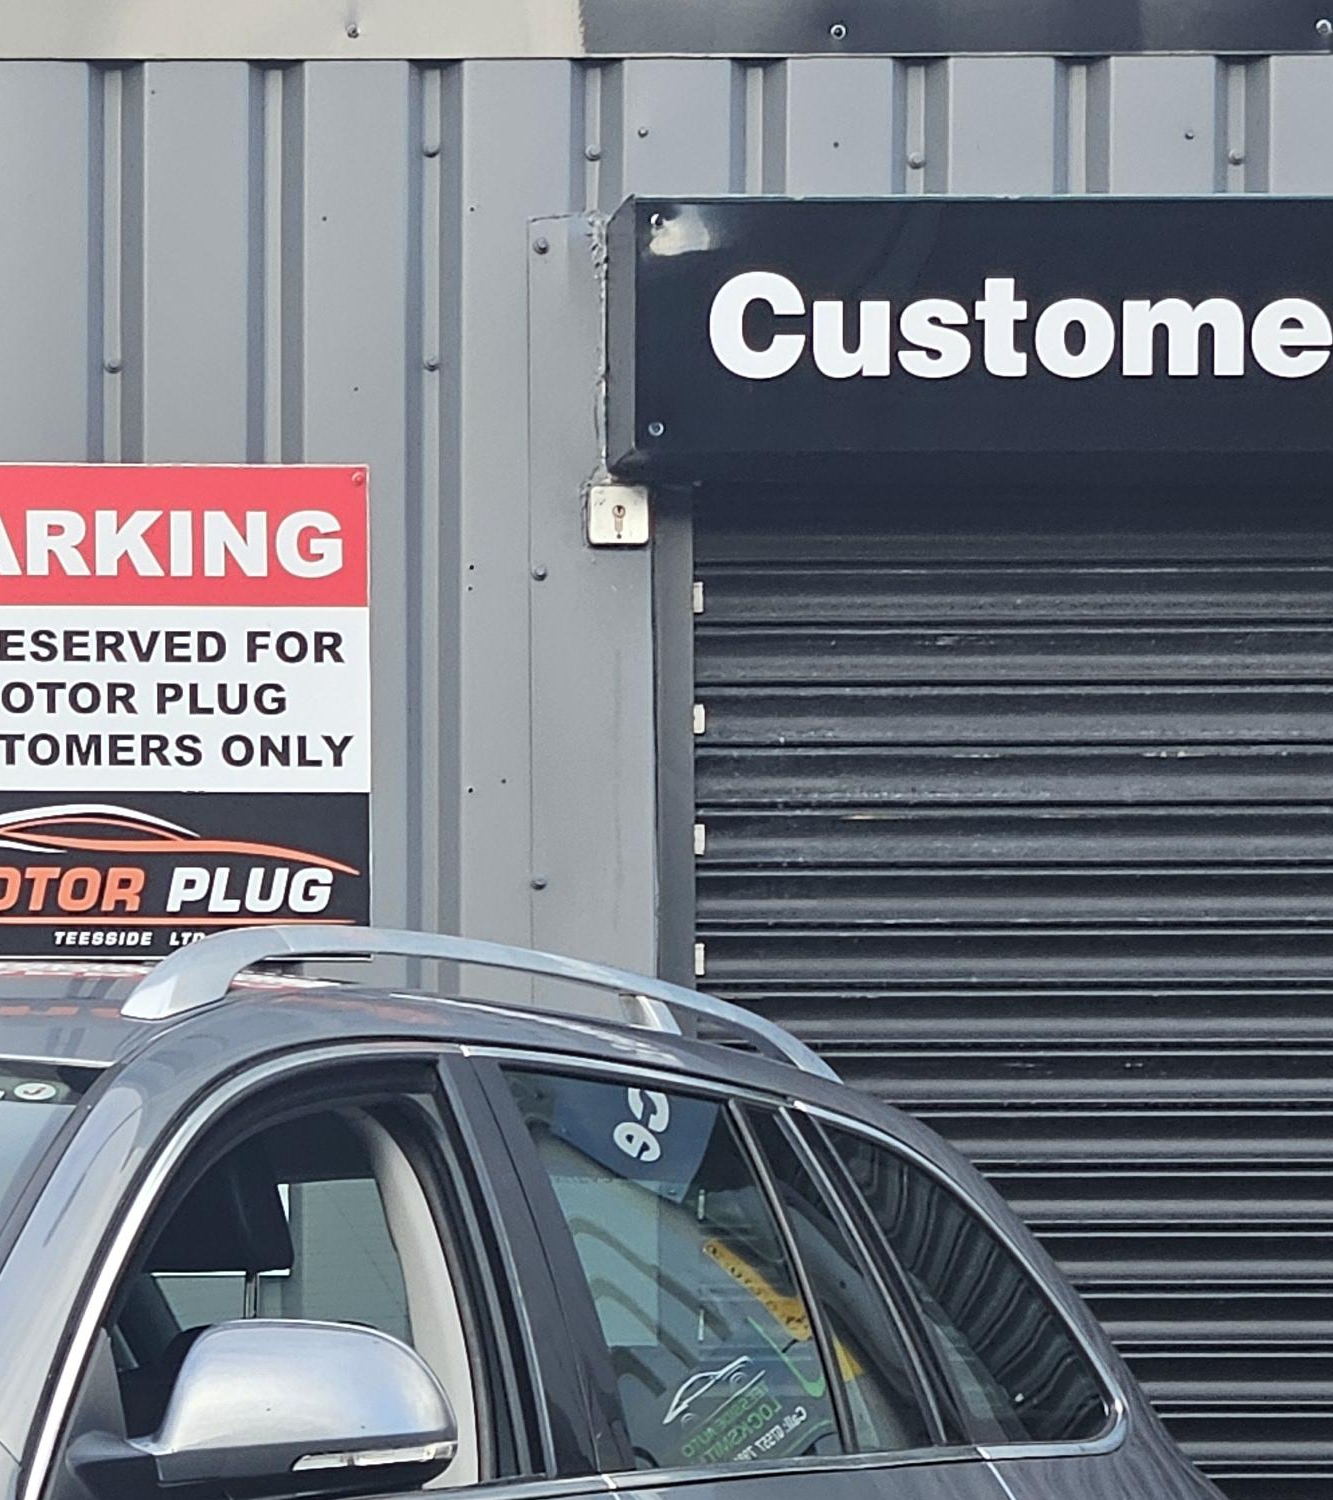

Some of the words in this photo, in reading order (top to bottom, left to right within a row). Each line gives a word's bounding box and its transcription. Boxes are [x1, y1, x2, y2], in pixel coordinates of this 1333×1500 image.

[708, 271, 1333, 379] Custome
[247, 631, 346, 664] FOR
[156, 683, 287, 715] PLUG
[221, 735, 354, 767] ONLY
[165, 867, 334, 914] PLUG
[54, 931, 153, 946] TEESSIDE
